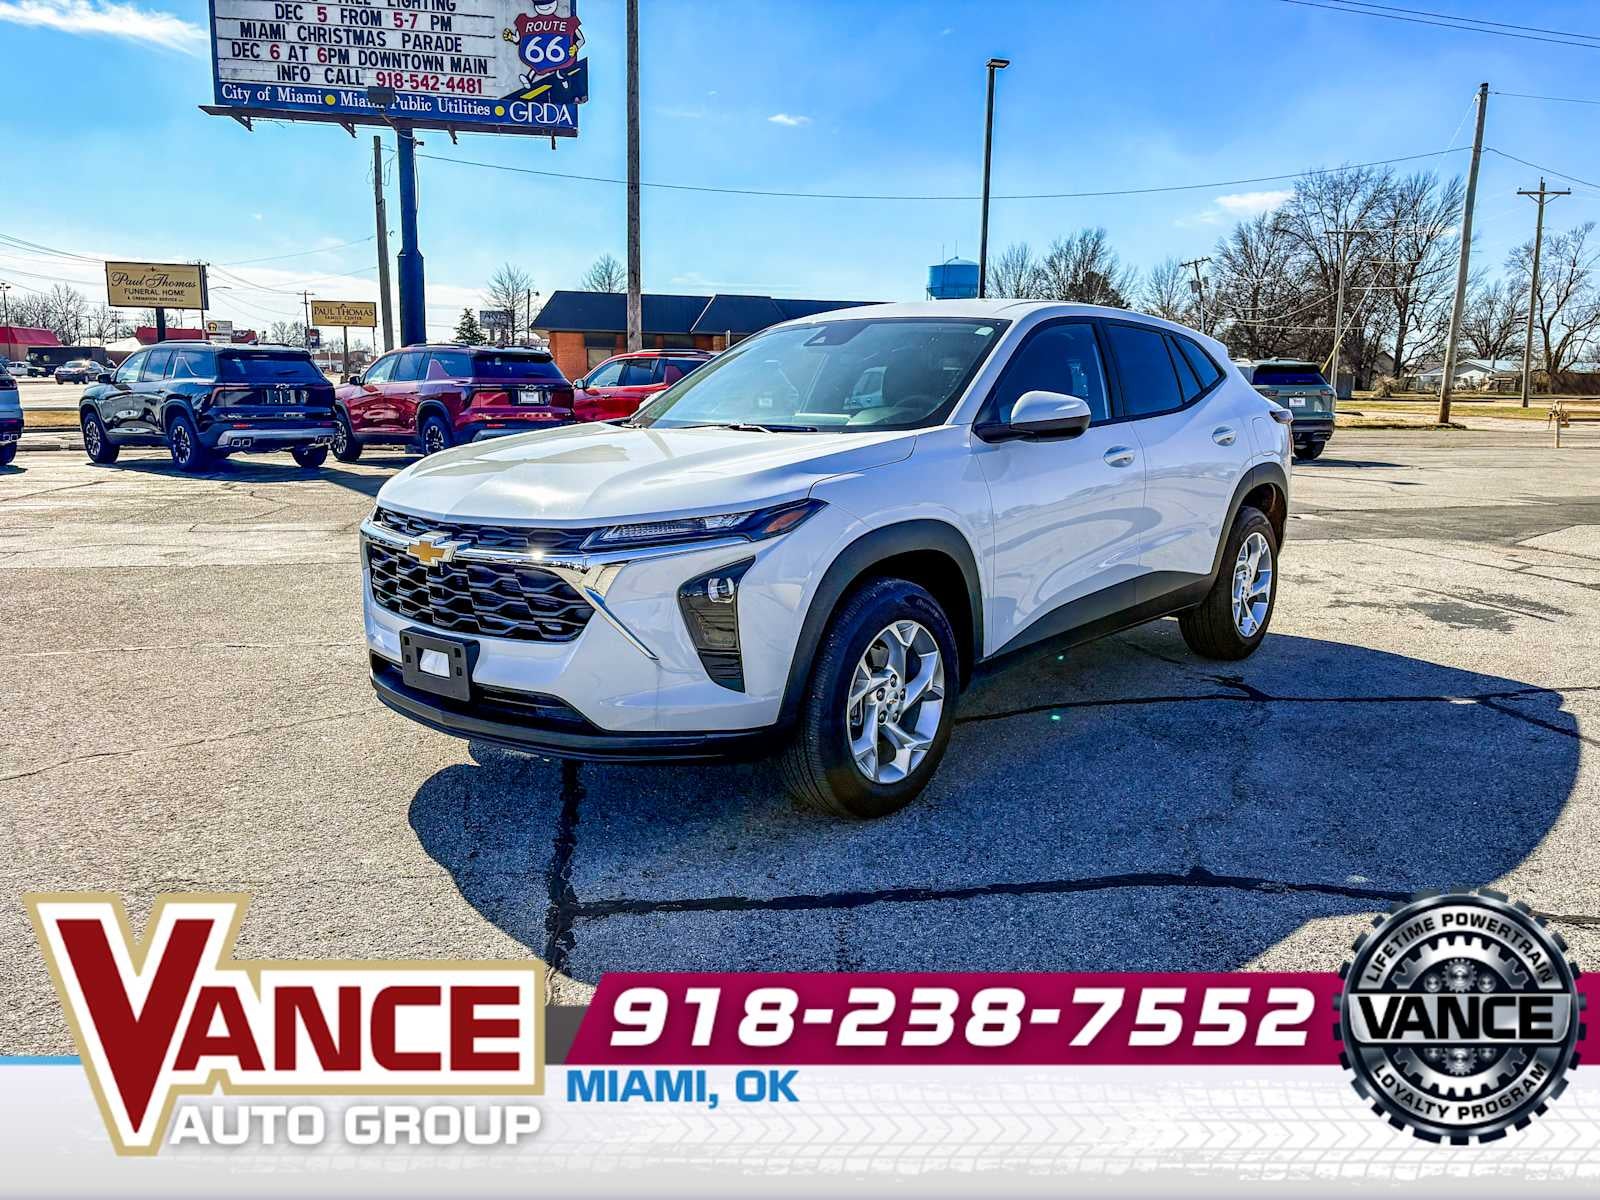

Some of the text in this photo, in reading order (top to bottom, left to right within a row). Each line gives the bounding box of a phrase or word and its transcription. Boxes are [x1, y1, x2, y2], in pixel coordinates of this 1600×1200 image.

[275, 3, 453, 32] DEC 5 FROM 5-7 PM
[525, 20, 568, 33] ROUTE
[240, 22, 463, 53] MIAMI CHRISTMAS PARADE
[524, 36, 566, 63] 66
[231, 41, 488, 75] DEC 6 AT 6PM DOWNTOWN MAIN
[276, 64, 483, 94] INFO CALL 918-542-4481
[221, 84, 251, 104] City
[256, 86, 271, 101] of
[276, 87, 323, 105] Miami
[438, 97, 491, 116] Utilities
[509, 101, 573, 125] GRDA
[111, 271, 197, 289] Paul Thomas
[124, 288, 185, 297] FUNERAL HOME
[314, 306, 374, 317] PAUL THOMAS
